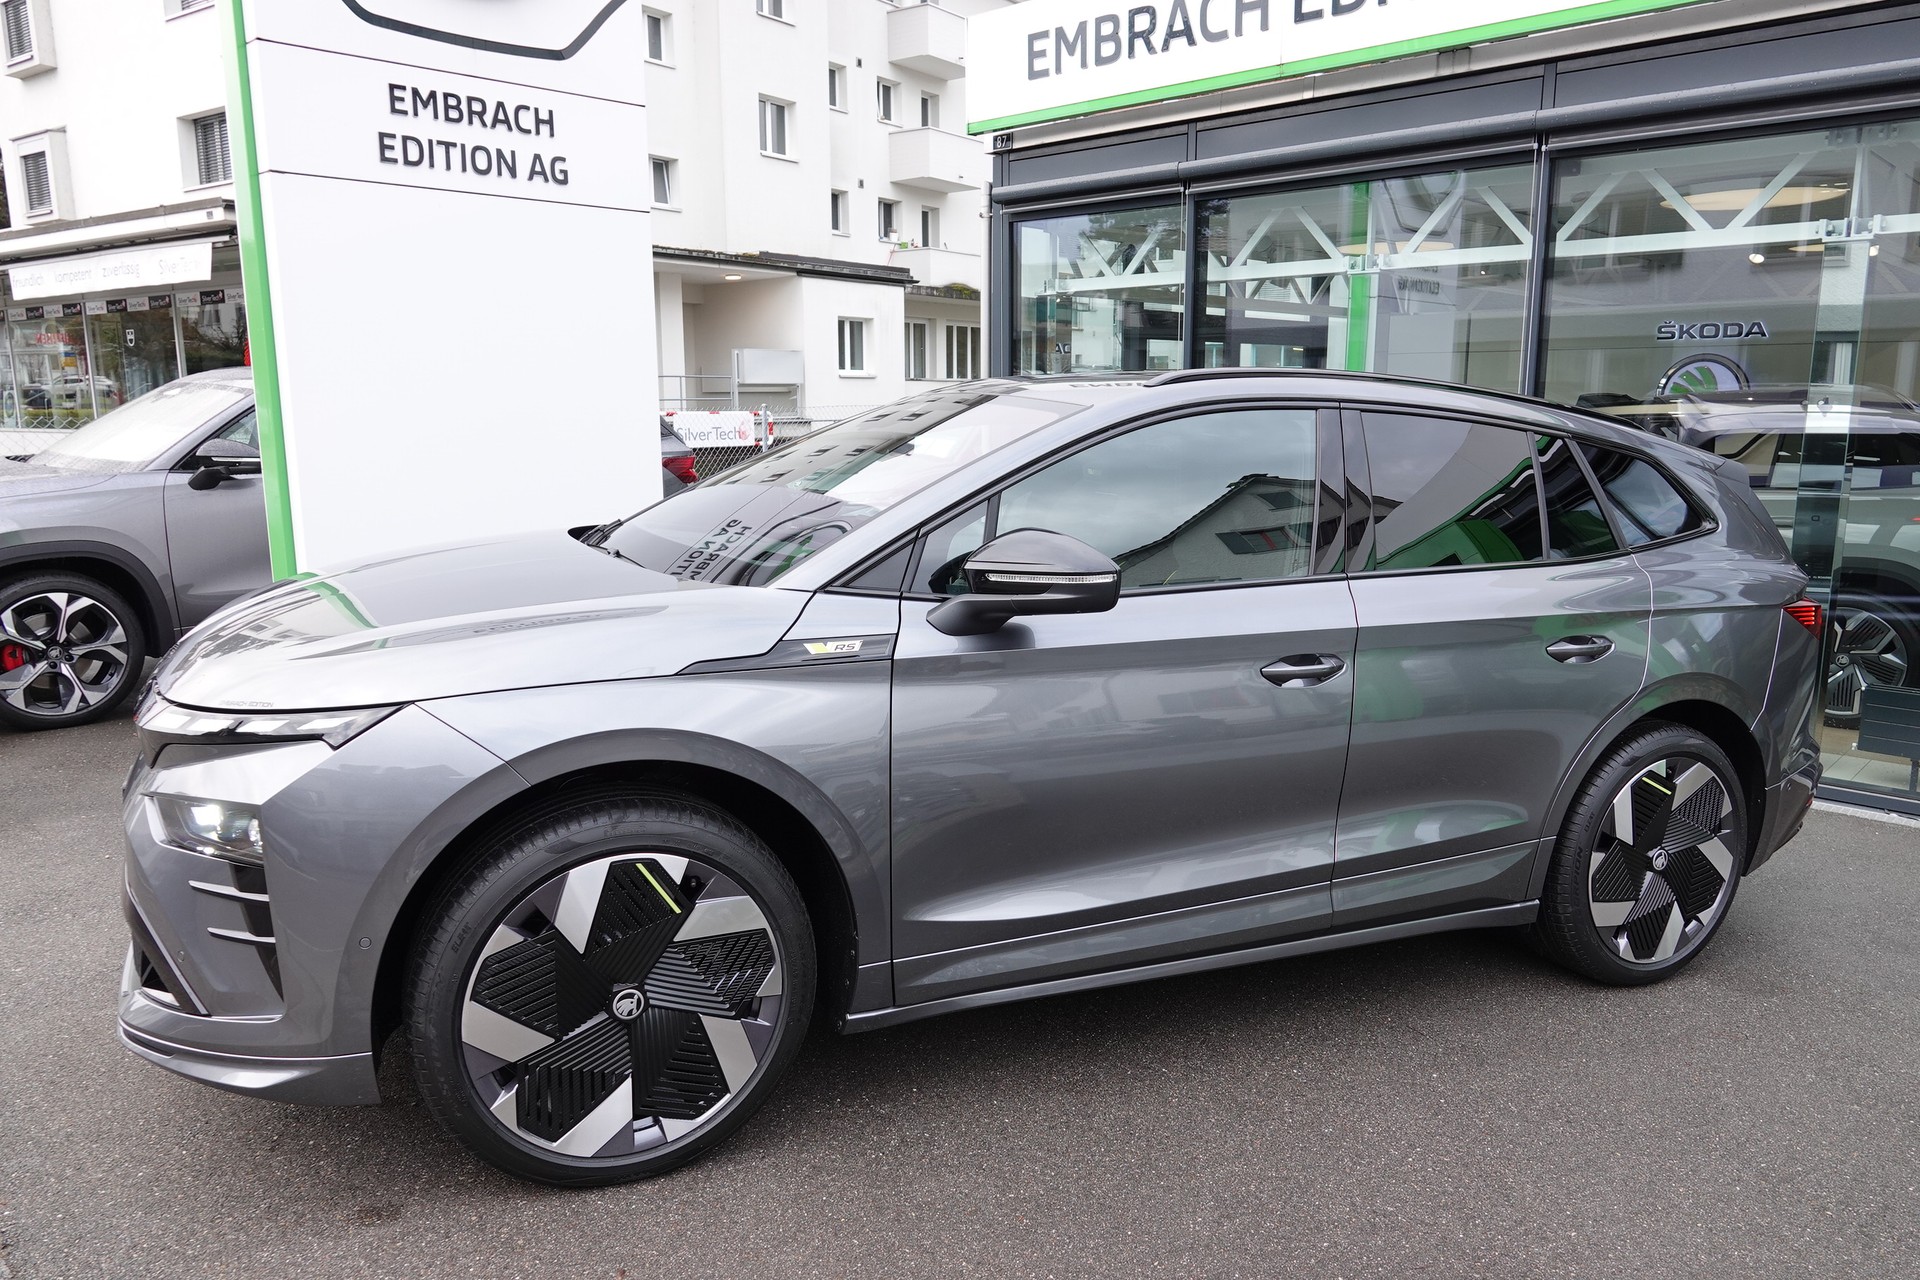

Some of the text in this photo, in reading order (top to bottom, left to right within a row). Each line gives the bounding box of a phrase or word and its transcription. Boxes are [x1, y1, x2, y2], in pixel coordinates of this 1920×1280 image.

[1027, 0, 1269, 80] EMBRACH
[388, 82, 555, 138] EMBRACH
[378, 131, 569, 186] EDITION AG
[997, 135, 1007, 148] 87
[1656, 320, 1768, 341] ŠKODA
[677, 427, 742, 442] SilverTech
